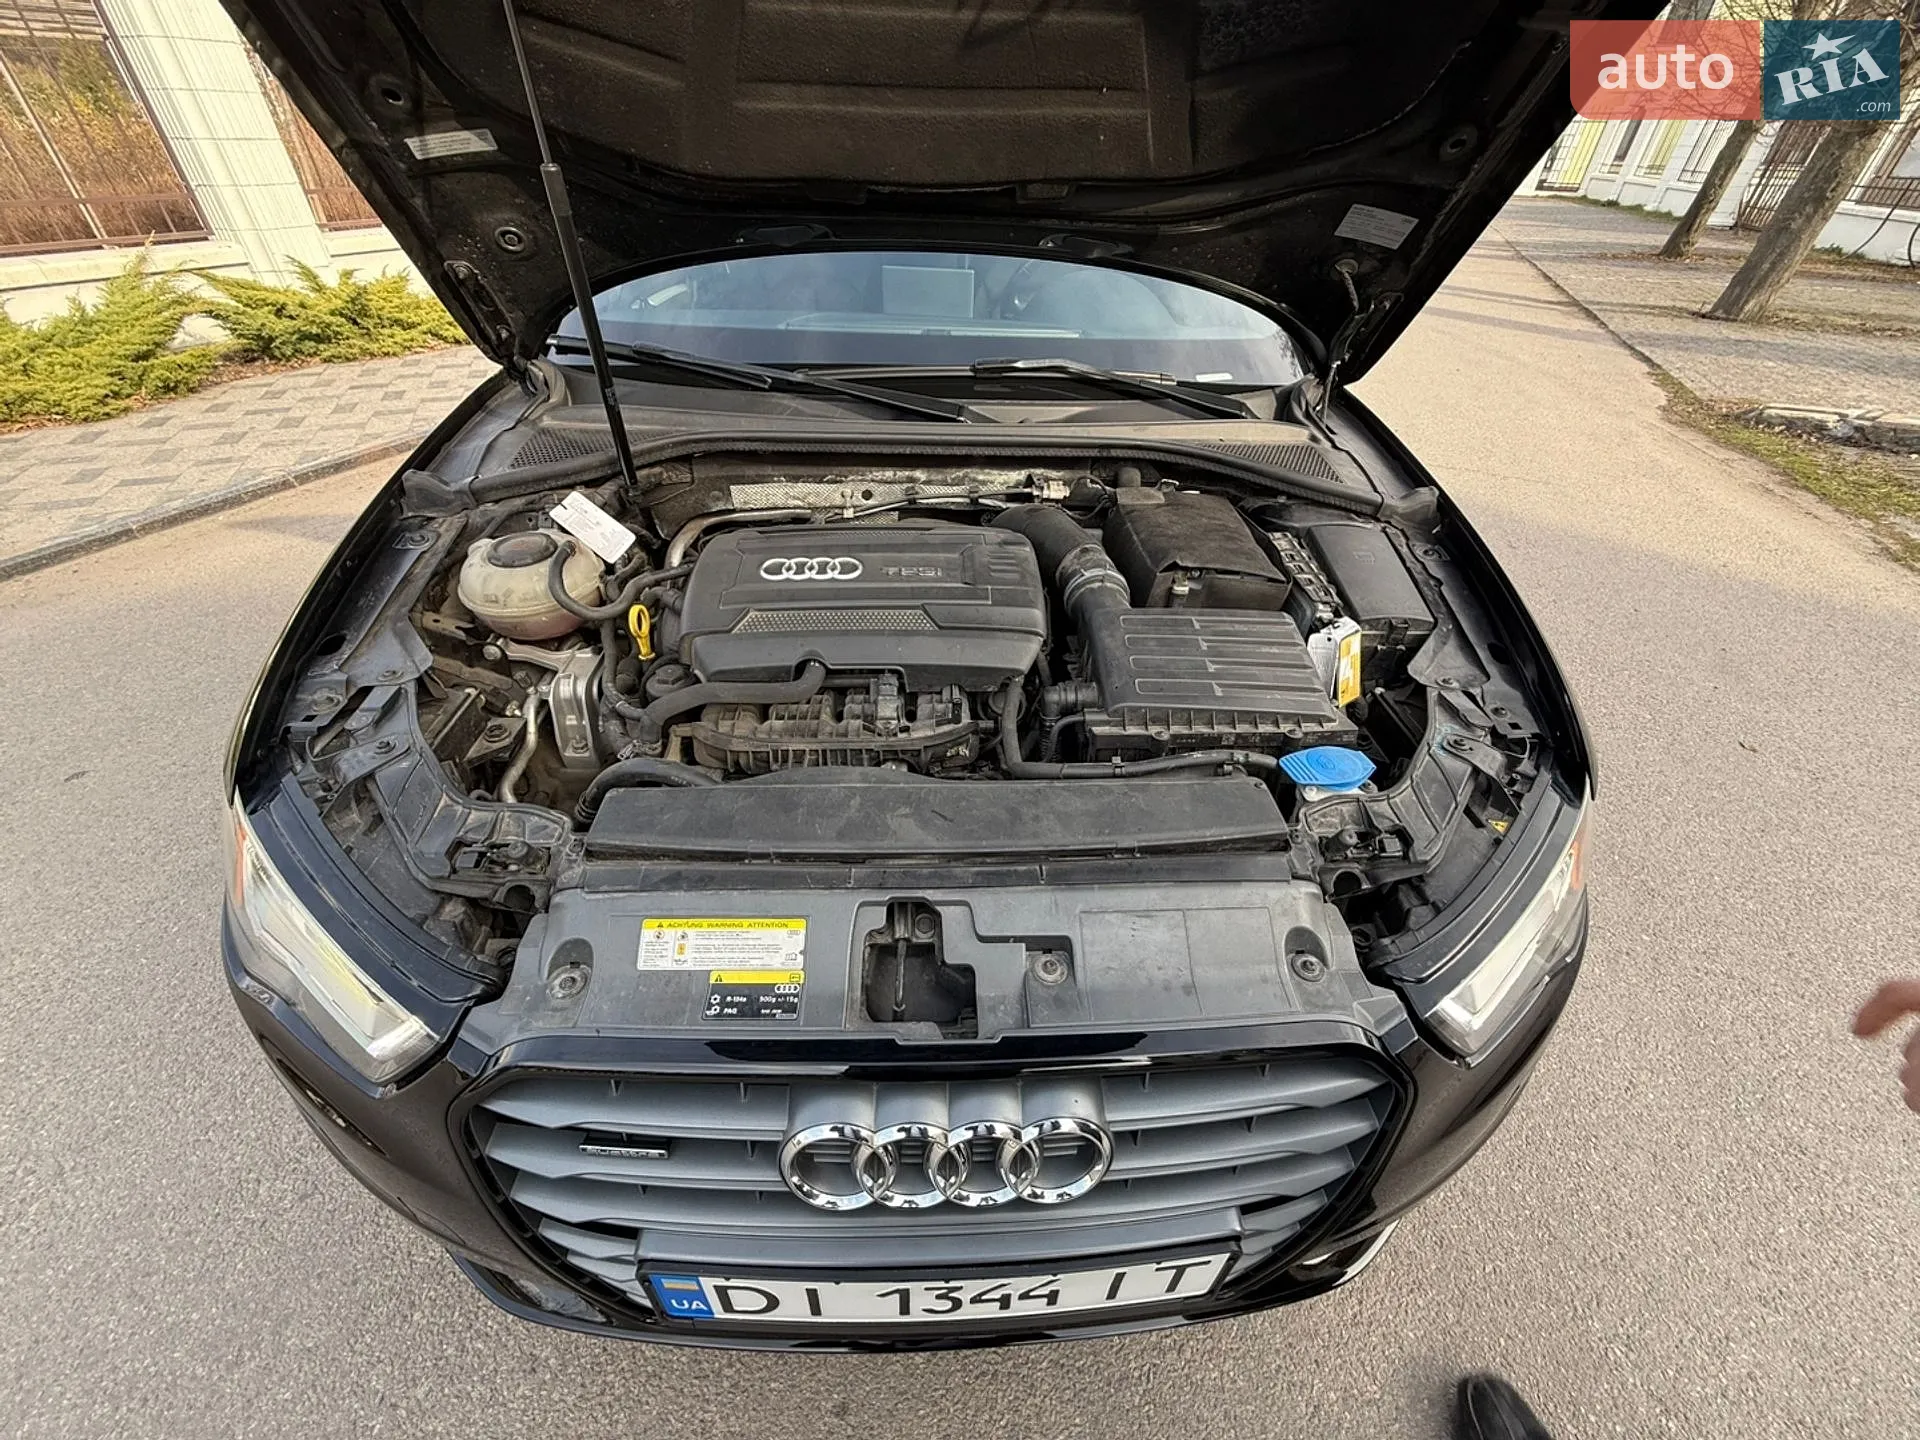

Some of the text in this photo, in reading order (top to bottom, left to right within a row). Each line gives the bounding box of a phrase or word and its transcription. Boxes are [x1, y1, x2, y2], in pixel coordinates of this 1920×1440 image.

[670, 1299, 709, 1311] UA
[713, 1259, 1212, 1317] DI 1344 IT
